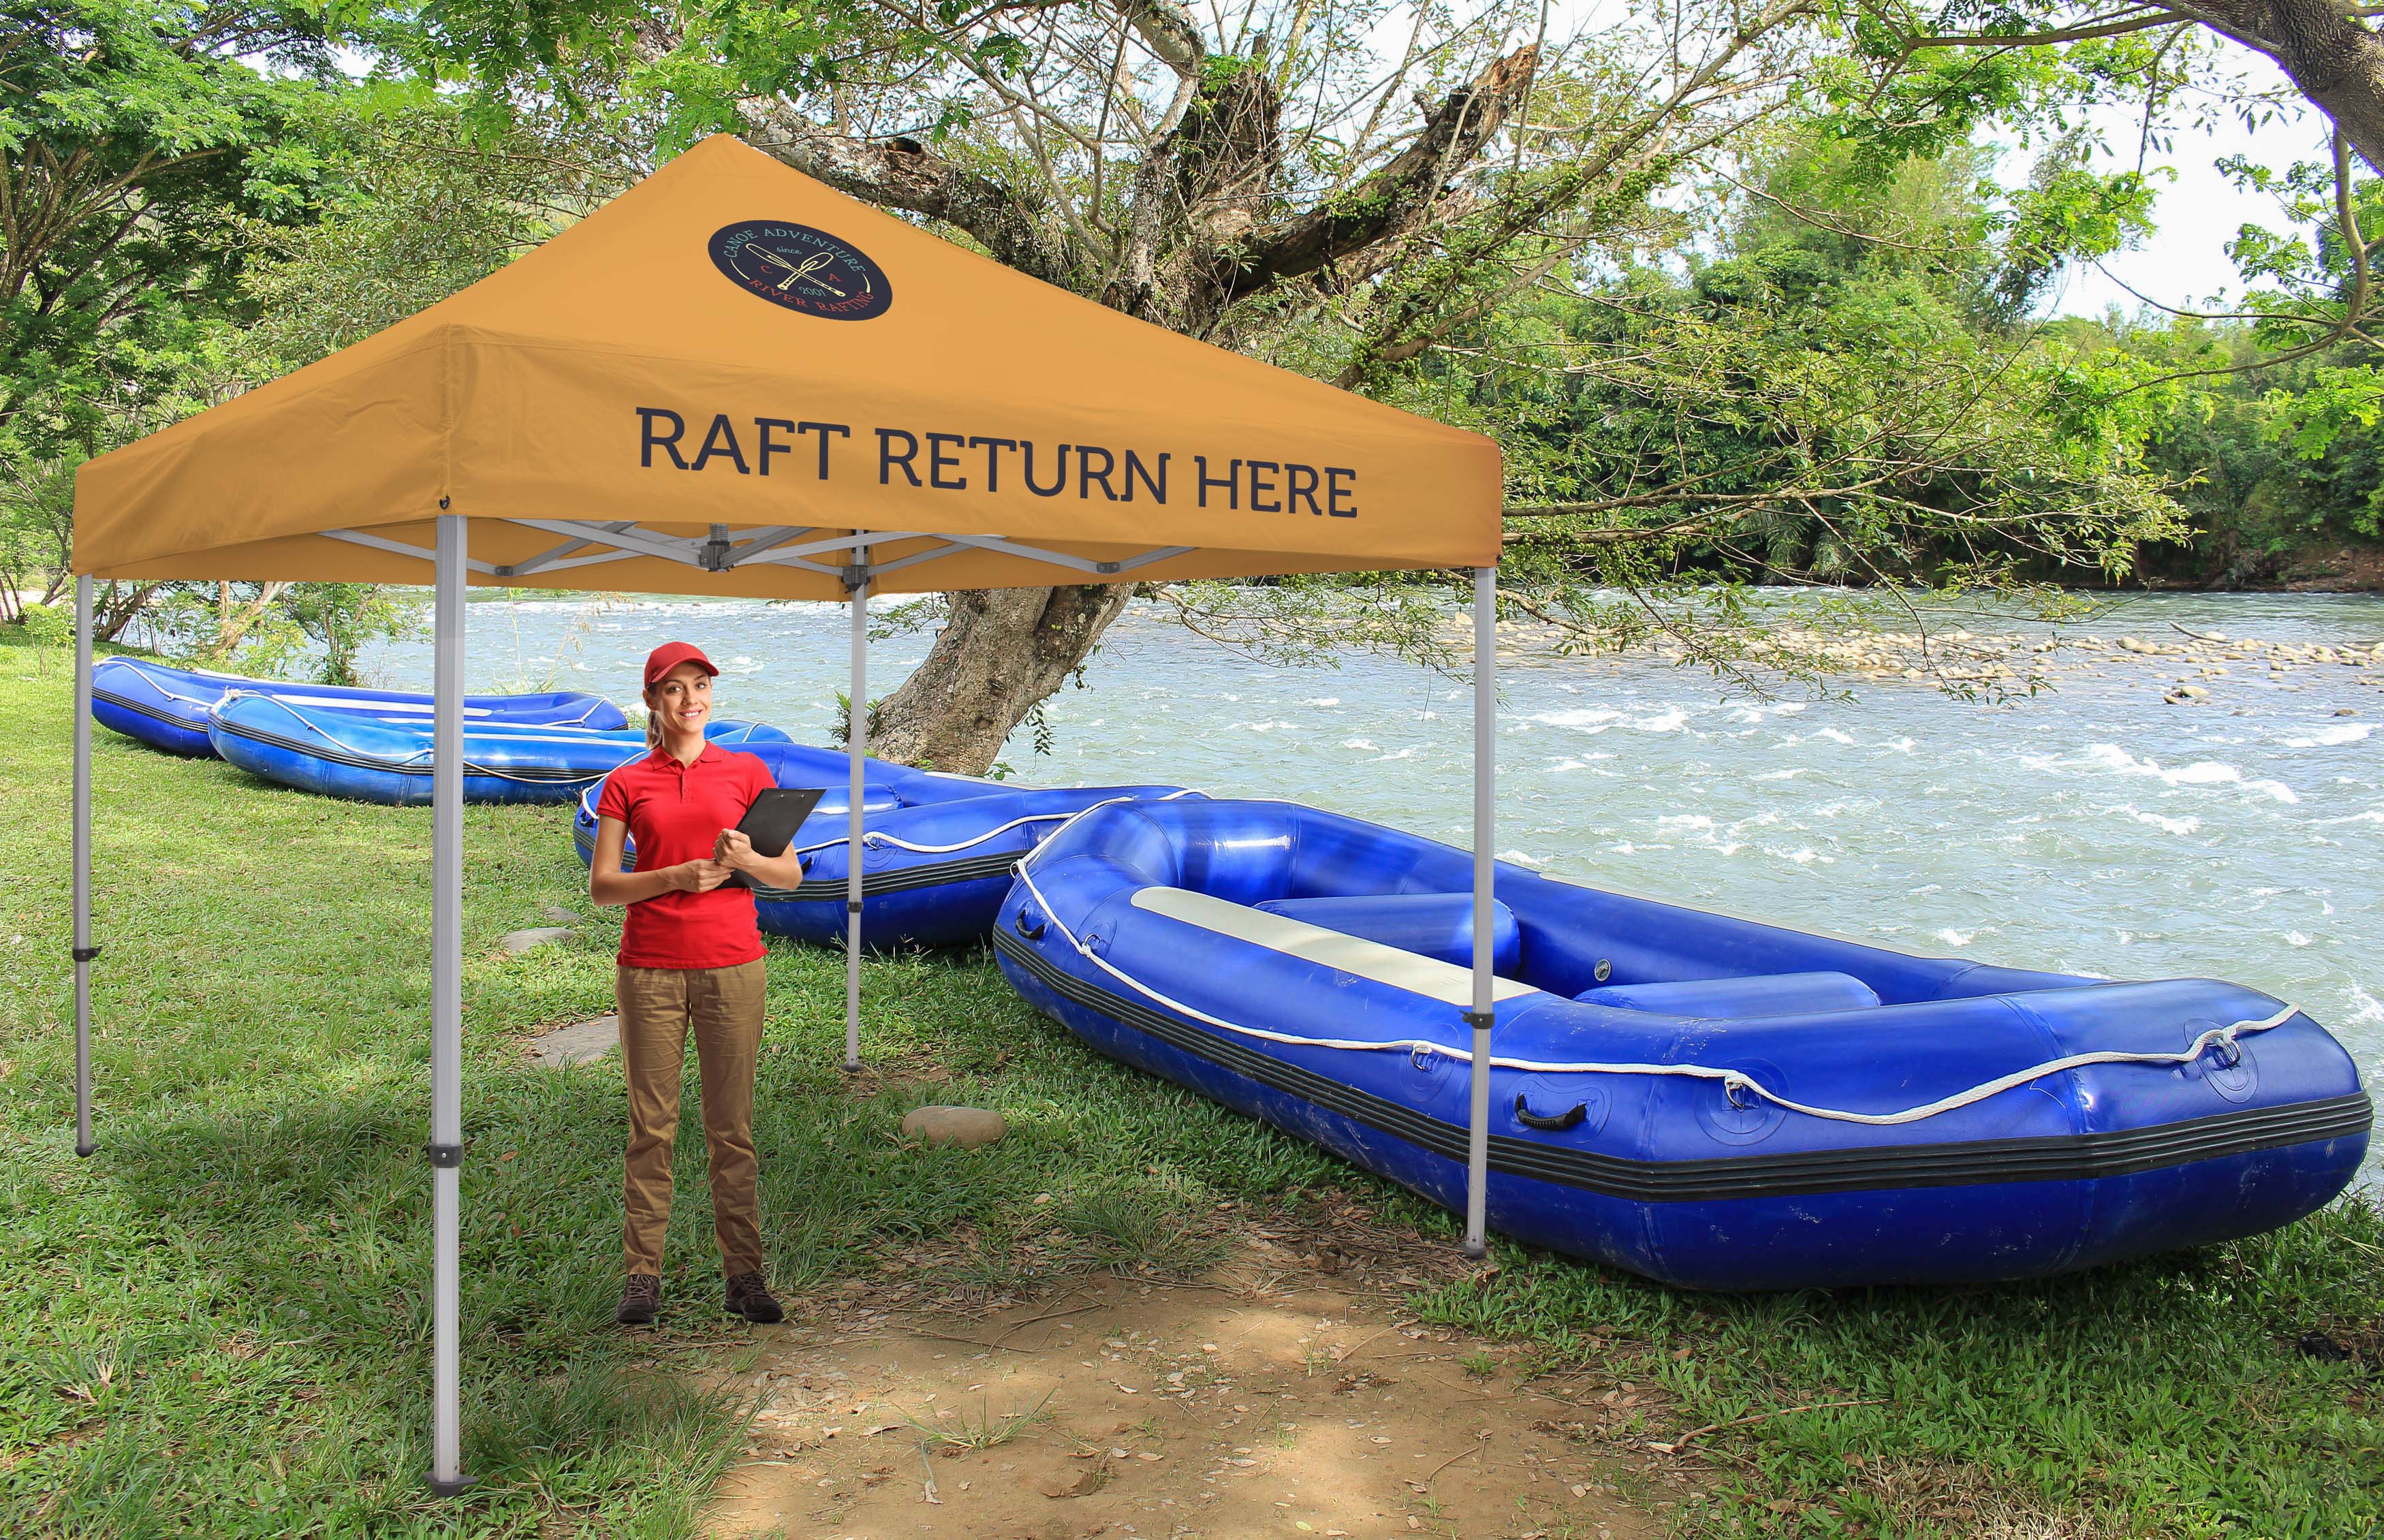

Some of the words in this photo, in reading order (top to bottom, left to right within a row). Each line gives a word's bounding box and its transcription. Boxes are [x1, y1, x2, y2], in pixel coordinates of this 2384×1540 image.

[723, 230, 757, 258] CANOE
[764, 228, 866, 272] ADVENTURE
[777, 246, 802, 255] since
[760, 265, 772, 274] C
[828, 273, 841, 283] A
[749, 279, 809, 307] RIVER
[814, 291, 874, 312] RAFTING
[798, 286, 827, 298] 2001
[636, 407, 850, 480] RAFT
[875, 428, 1170, 504] RETURN
[1195, 456, 1357, 518] HERE
